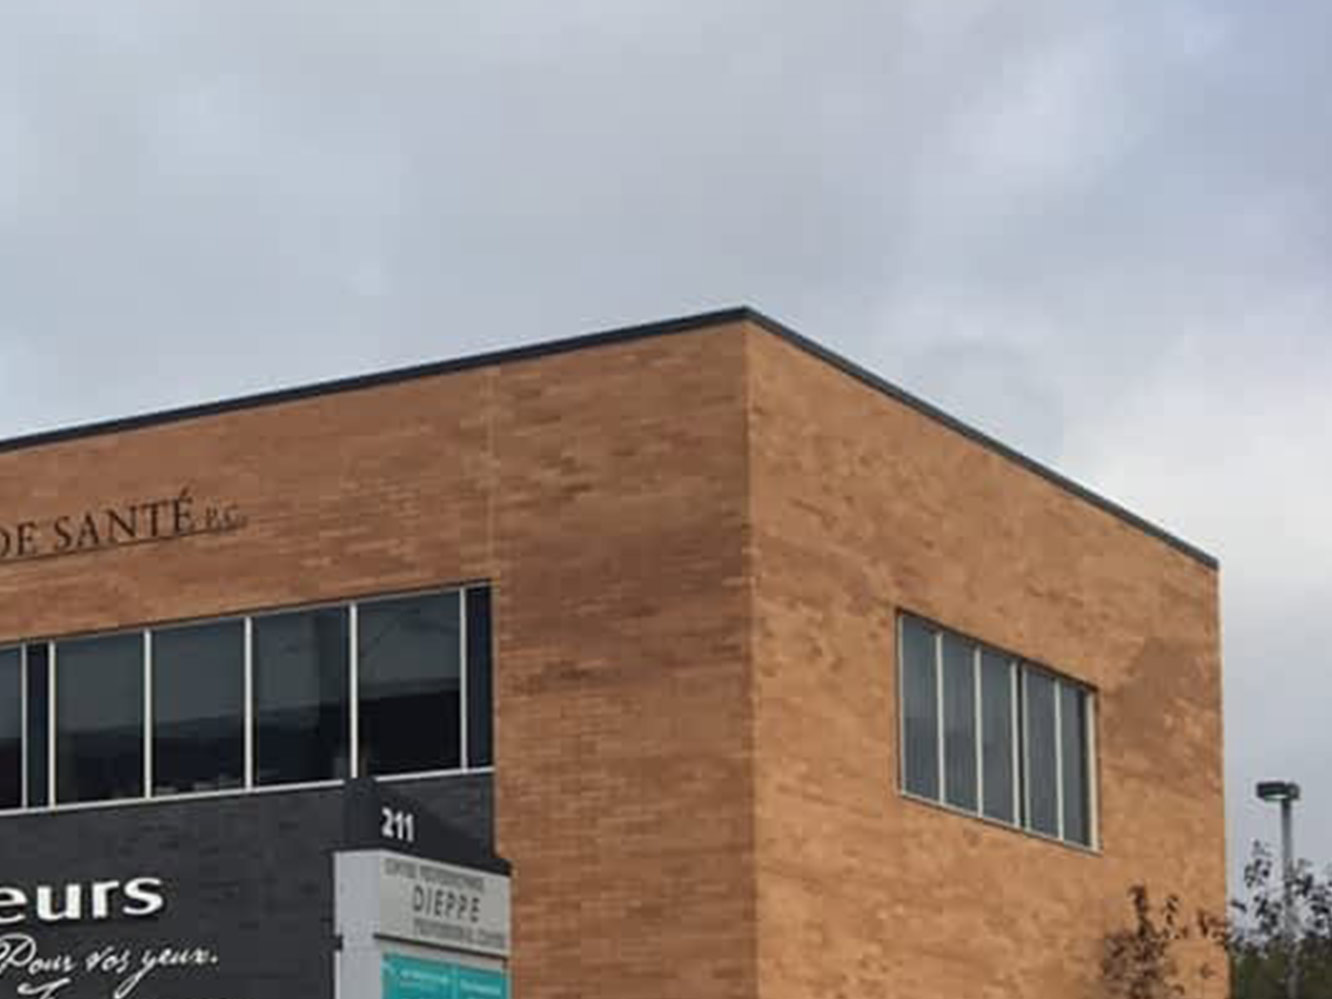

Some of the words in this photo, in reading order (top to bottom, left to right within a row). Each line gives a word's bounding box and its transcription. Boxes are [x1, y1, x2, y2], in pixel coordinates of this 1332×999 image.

[52, 486, 194, 552] SANTÉ
[381, 805, 415, 844] 211
[412, 883, 481, 924] DIEPPE
